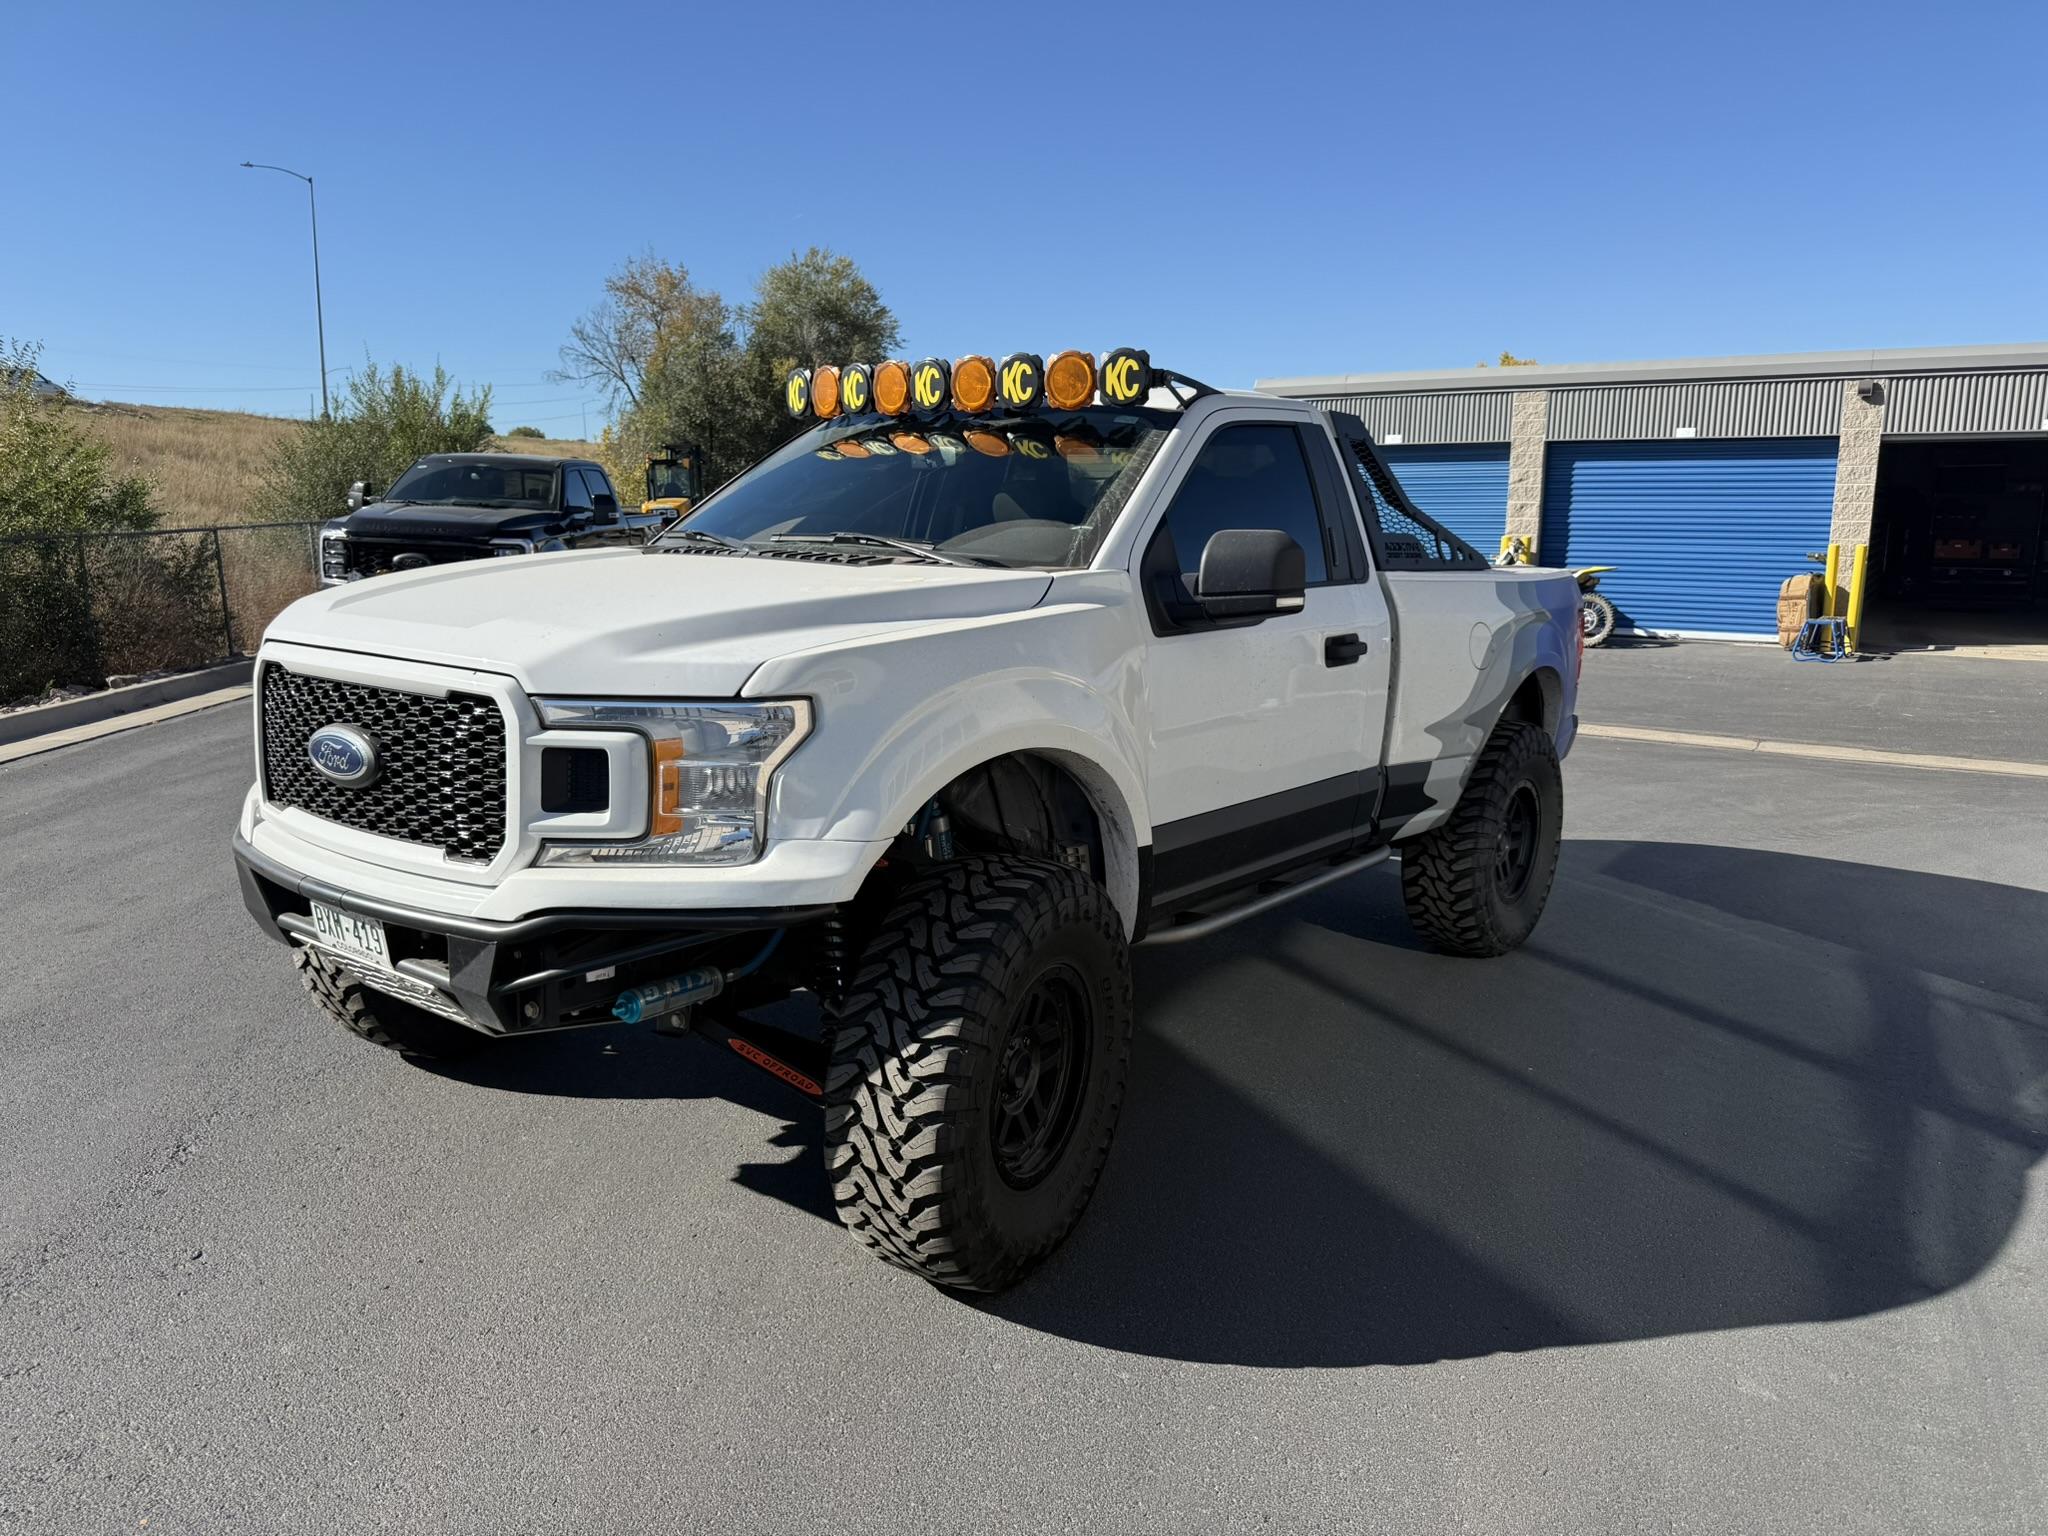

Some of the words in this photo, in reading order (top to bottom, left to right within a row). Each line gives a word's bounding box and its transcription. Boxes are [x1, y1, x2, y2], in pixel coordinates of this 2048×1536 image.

[788, 375, 804, 412] KC
[843, 370, 864, 410] KC
[914, 365, 941, 407] KC
[1002, 360, 1033, 404] KC
[1105, 356, 1140, 401] KC
[317, 740, 351, 771] Ford
[737, 1044, 761, 1060] SVC
[763, 1058, 815, 1090] OFFROAD
